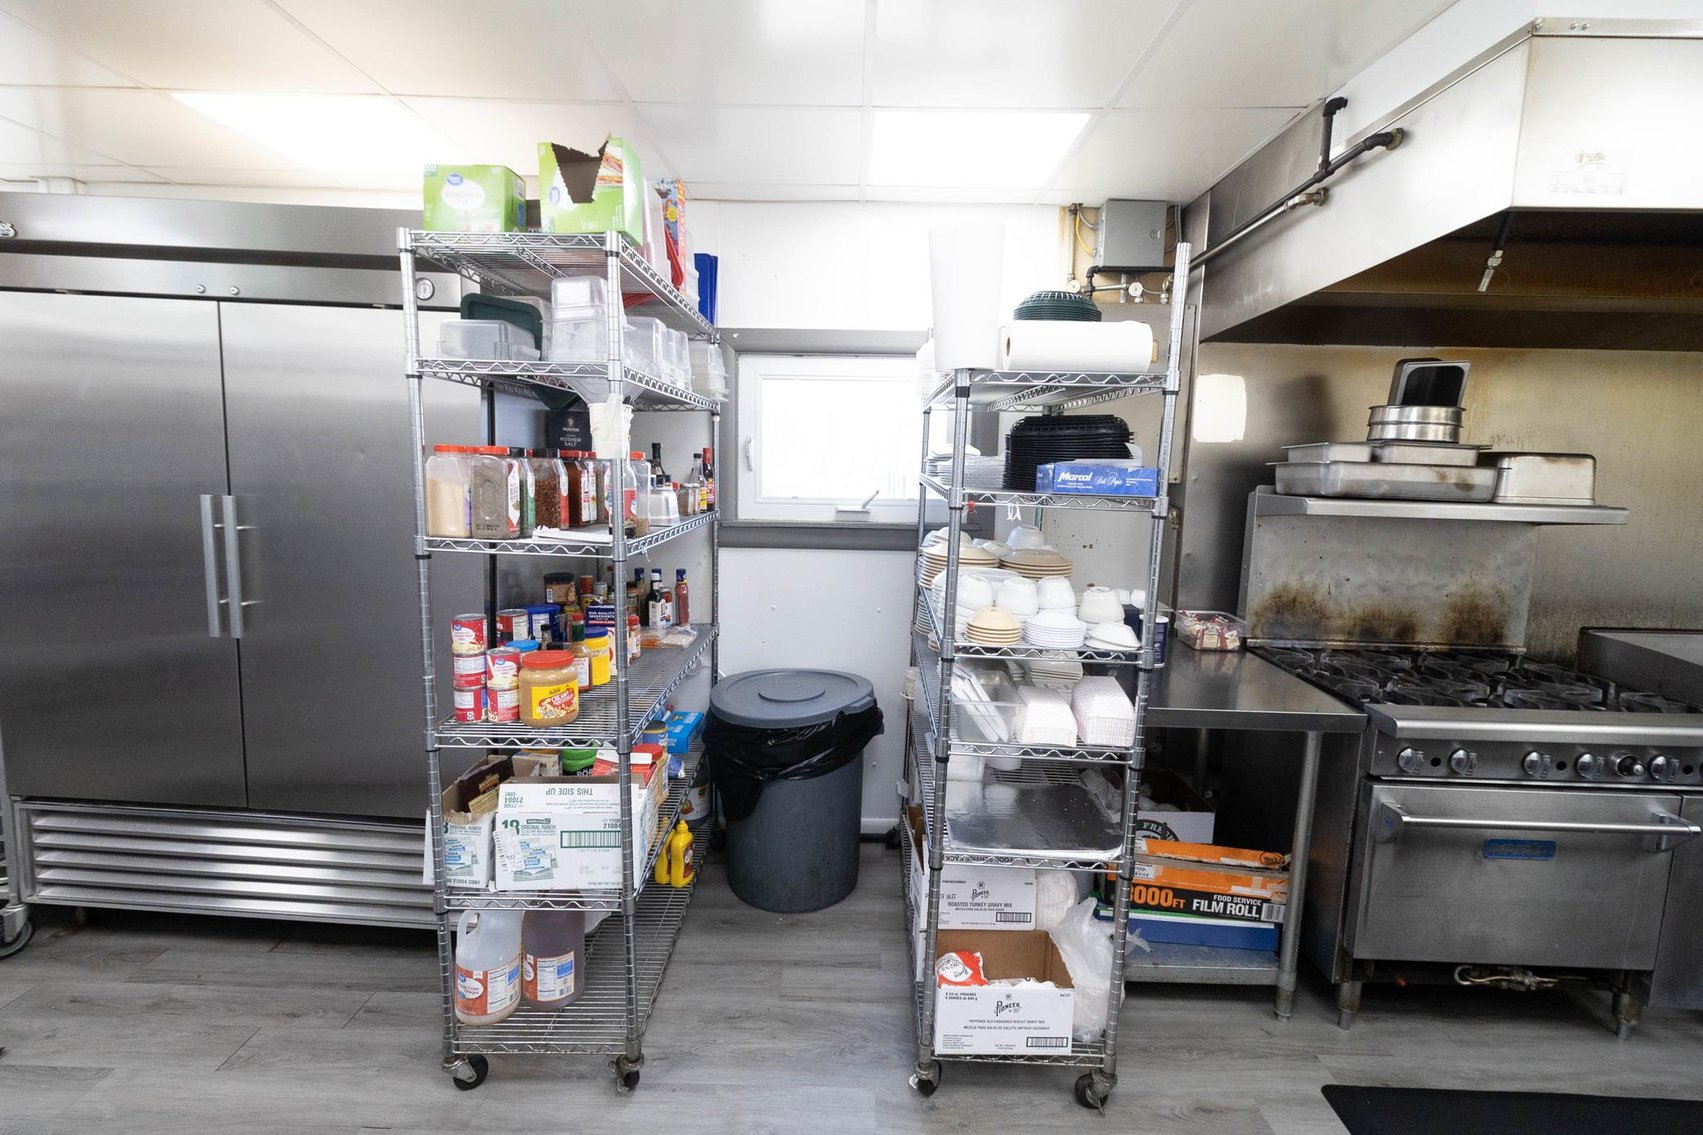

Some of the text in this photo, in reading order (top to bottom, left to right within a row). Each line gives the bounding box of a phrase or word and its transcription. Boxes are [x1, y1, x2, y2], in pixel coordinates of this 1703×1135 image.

[1058, 472, 1094, 482] Marcal
[545, 788, 593, 796] THIS SIDE UP
[1213, 894, 1262, 906] FOOD SERVICE
[1192, 899, 1260, 918] FILM ROLL
[995, 1001, 1021, 1017] PIONEER
